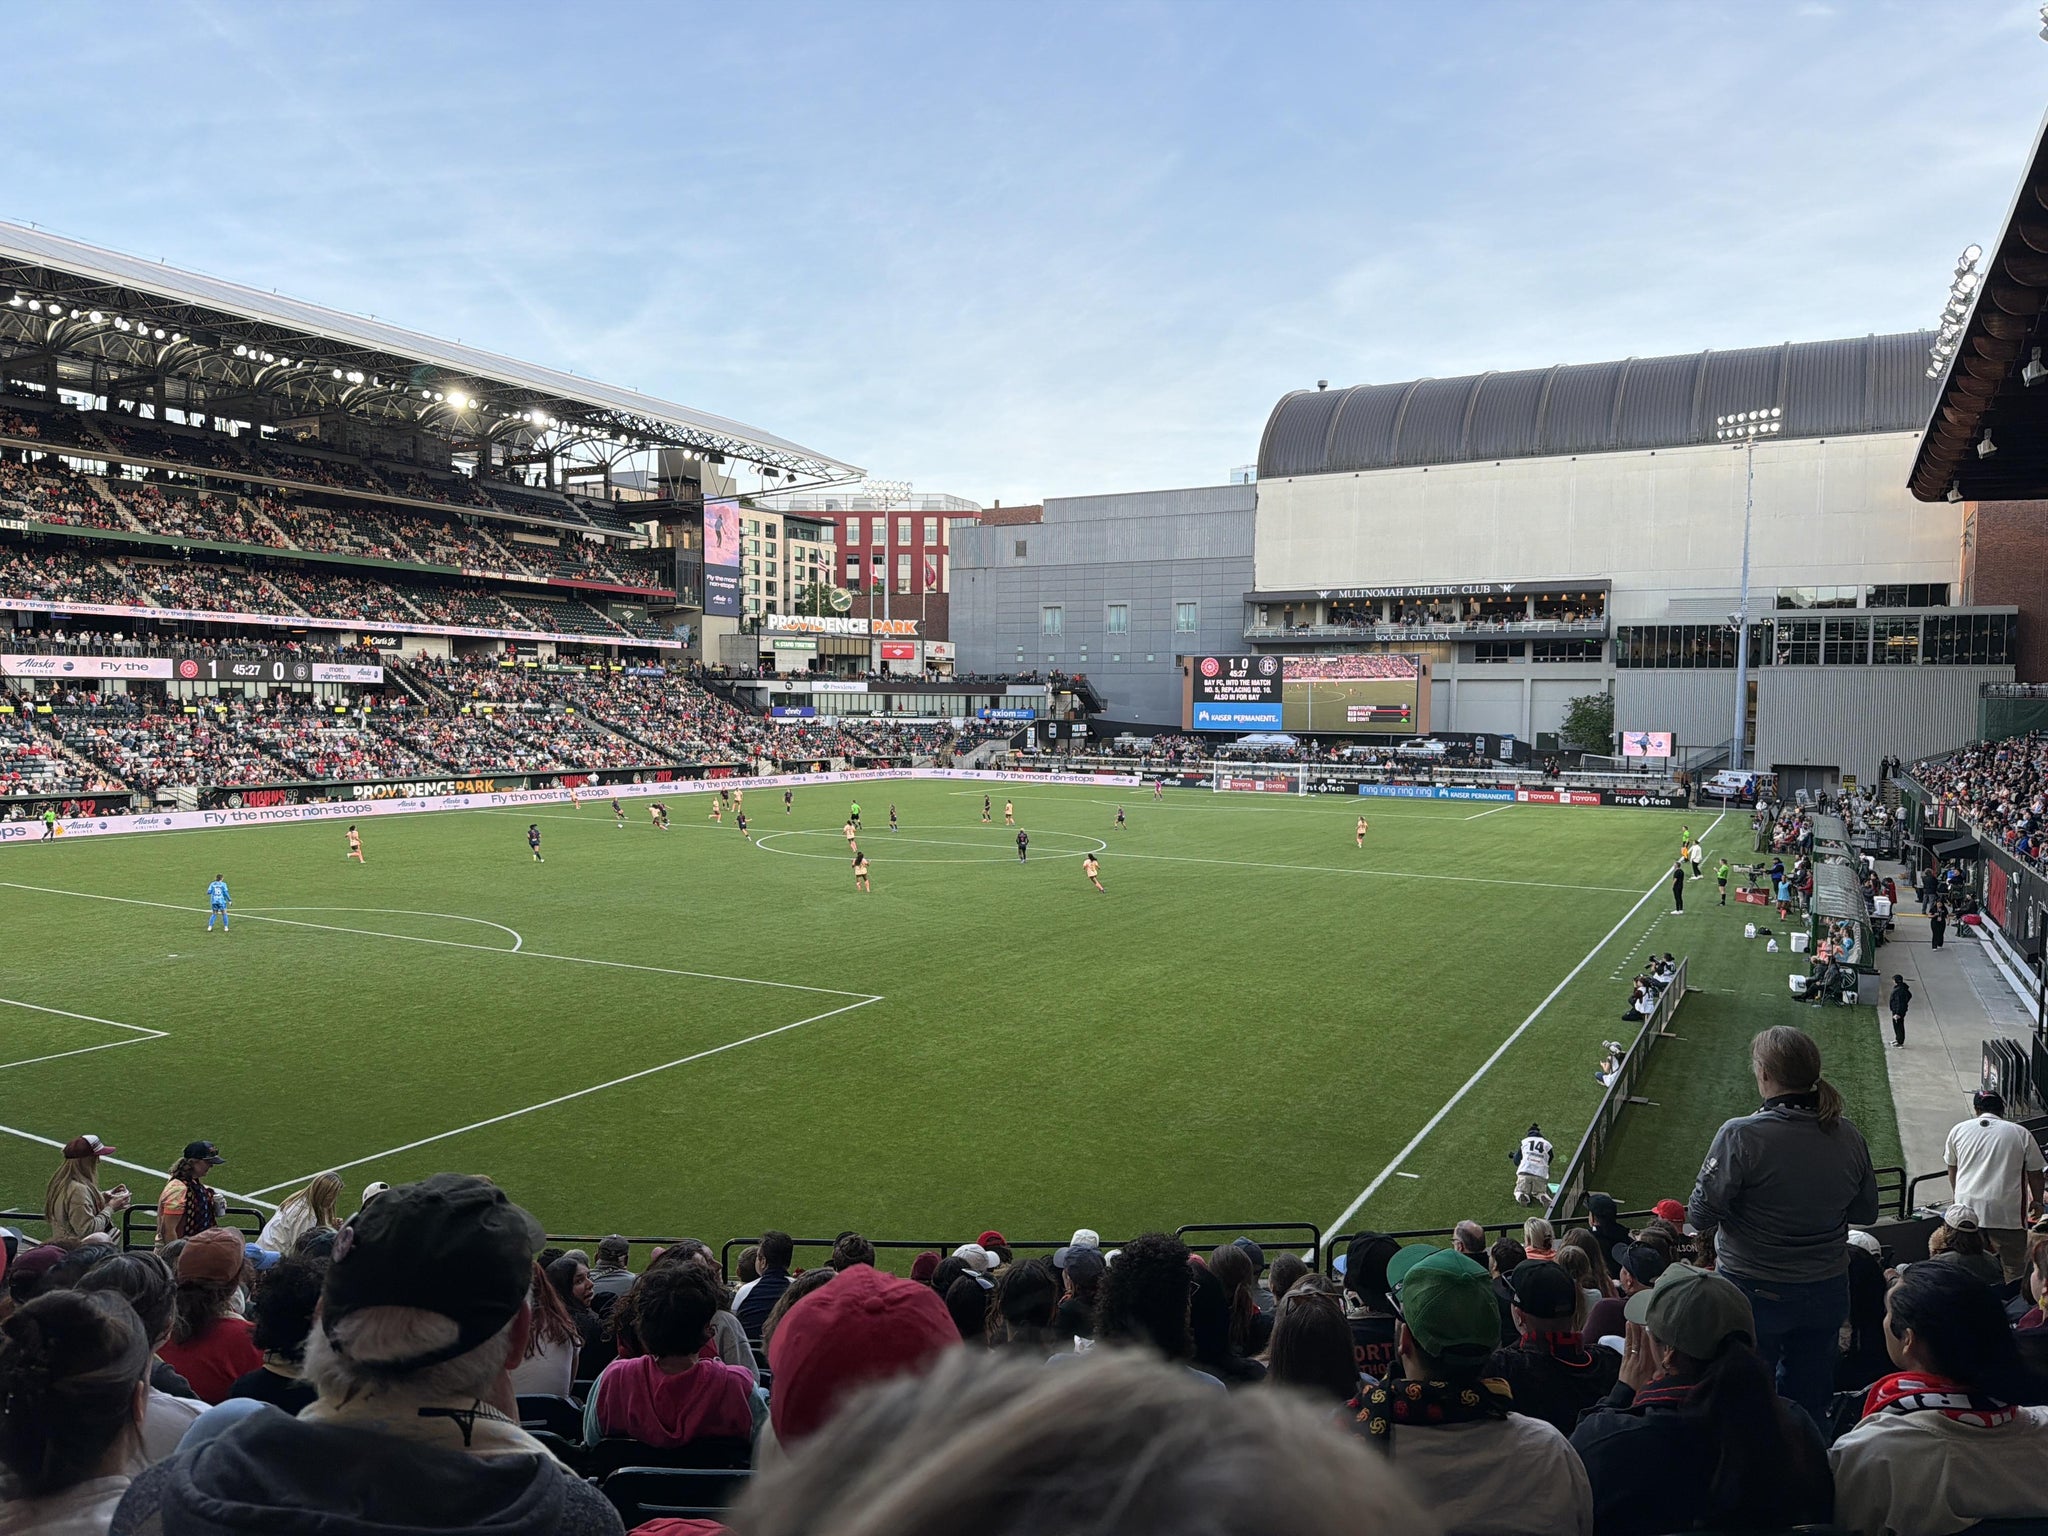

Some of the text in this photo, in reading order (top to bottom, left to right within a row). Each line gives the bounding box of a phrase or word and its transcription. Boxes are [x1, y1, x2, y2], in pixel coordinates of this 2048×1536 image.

[1338, 585, 1491, 599] MULTNOMAH ATHLETIC CLUB
[767, 614, 919, 636] PROVIDENCE PARK
[16, 658, 56, 668] Alaska
[101, 661, 149, 672] Fly the
[1228, 658, 1249, 670] 1 0
[208, 660, 218, 679] 1
[232, 664, 261, 676] 45:27
[272, 662, 285, 681] 0
[784, 708, 802, 716] xfinity
[992, 709, 1016, 717] axiom
[656, 770, 672, 782] 2012
[996, 772, 1008, 782] Fly
[1050, 775, 1094, 783] non-stops
[456, 779, 496, 793] PARK
[693, 778, 778, 791] Fly the most non-stops
[491, 786, 610, 804] Fly the most no-stops
[1362, 787, 1432, 798] ring ring ring ring
[397, 800, 416, 808] Alaska
[1616, 796, 1671, 806] First Tech
[62, 800, 96, 817] 212
[204, 802, 372, 824] Fly the most non-stops
[65, 820, 94, 831] Alaska
[132, 816, 160, 826] Alaska
[0, 826, 26, 840] ps
[1528, 1140, 1544, 1154] 14
